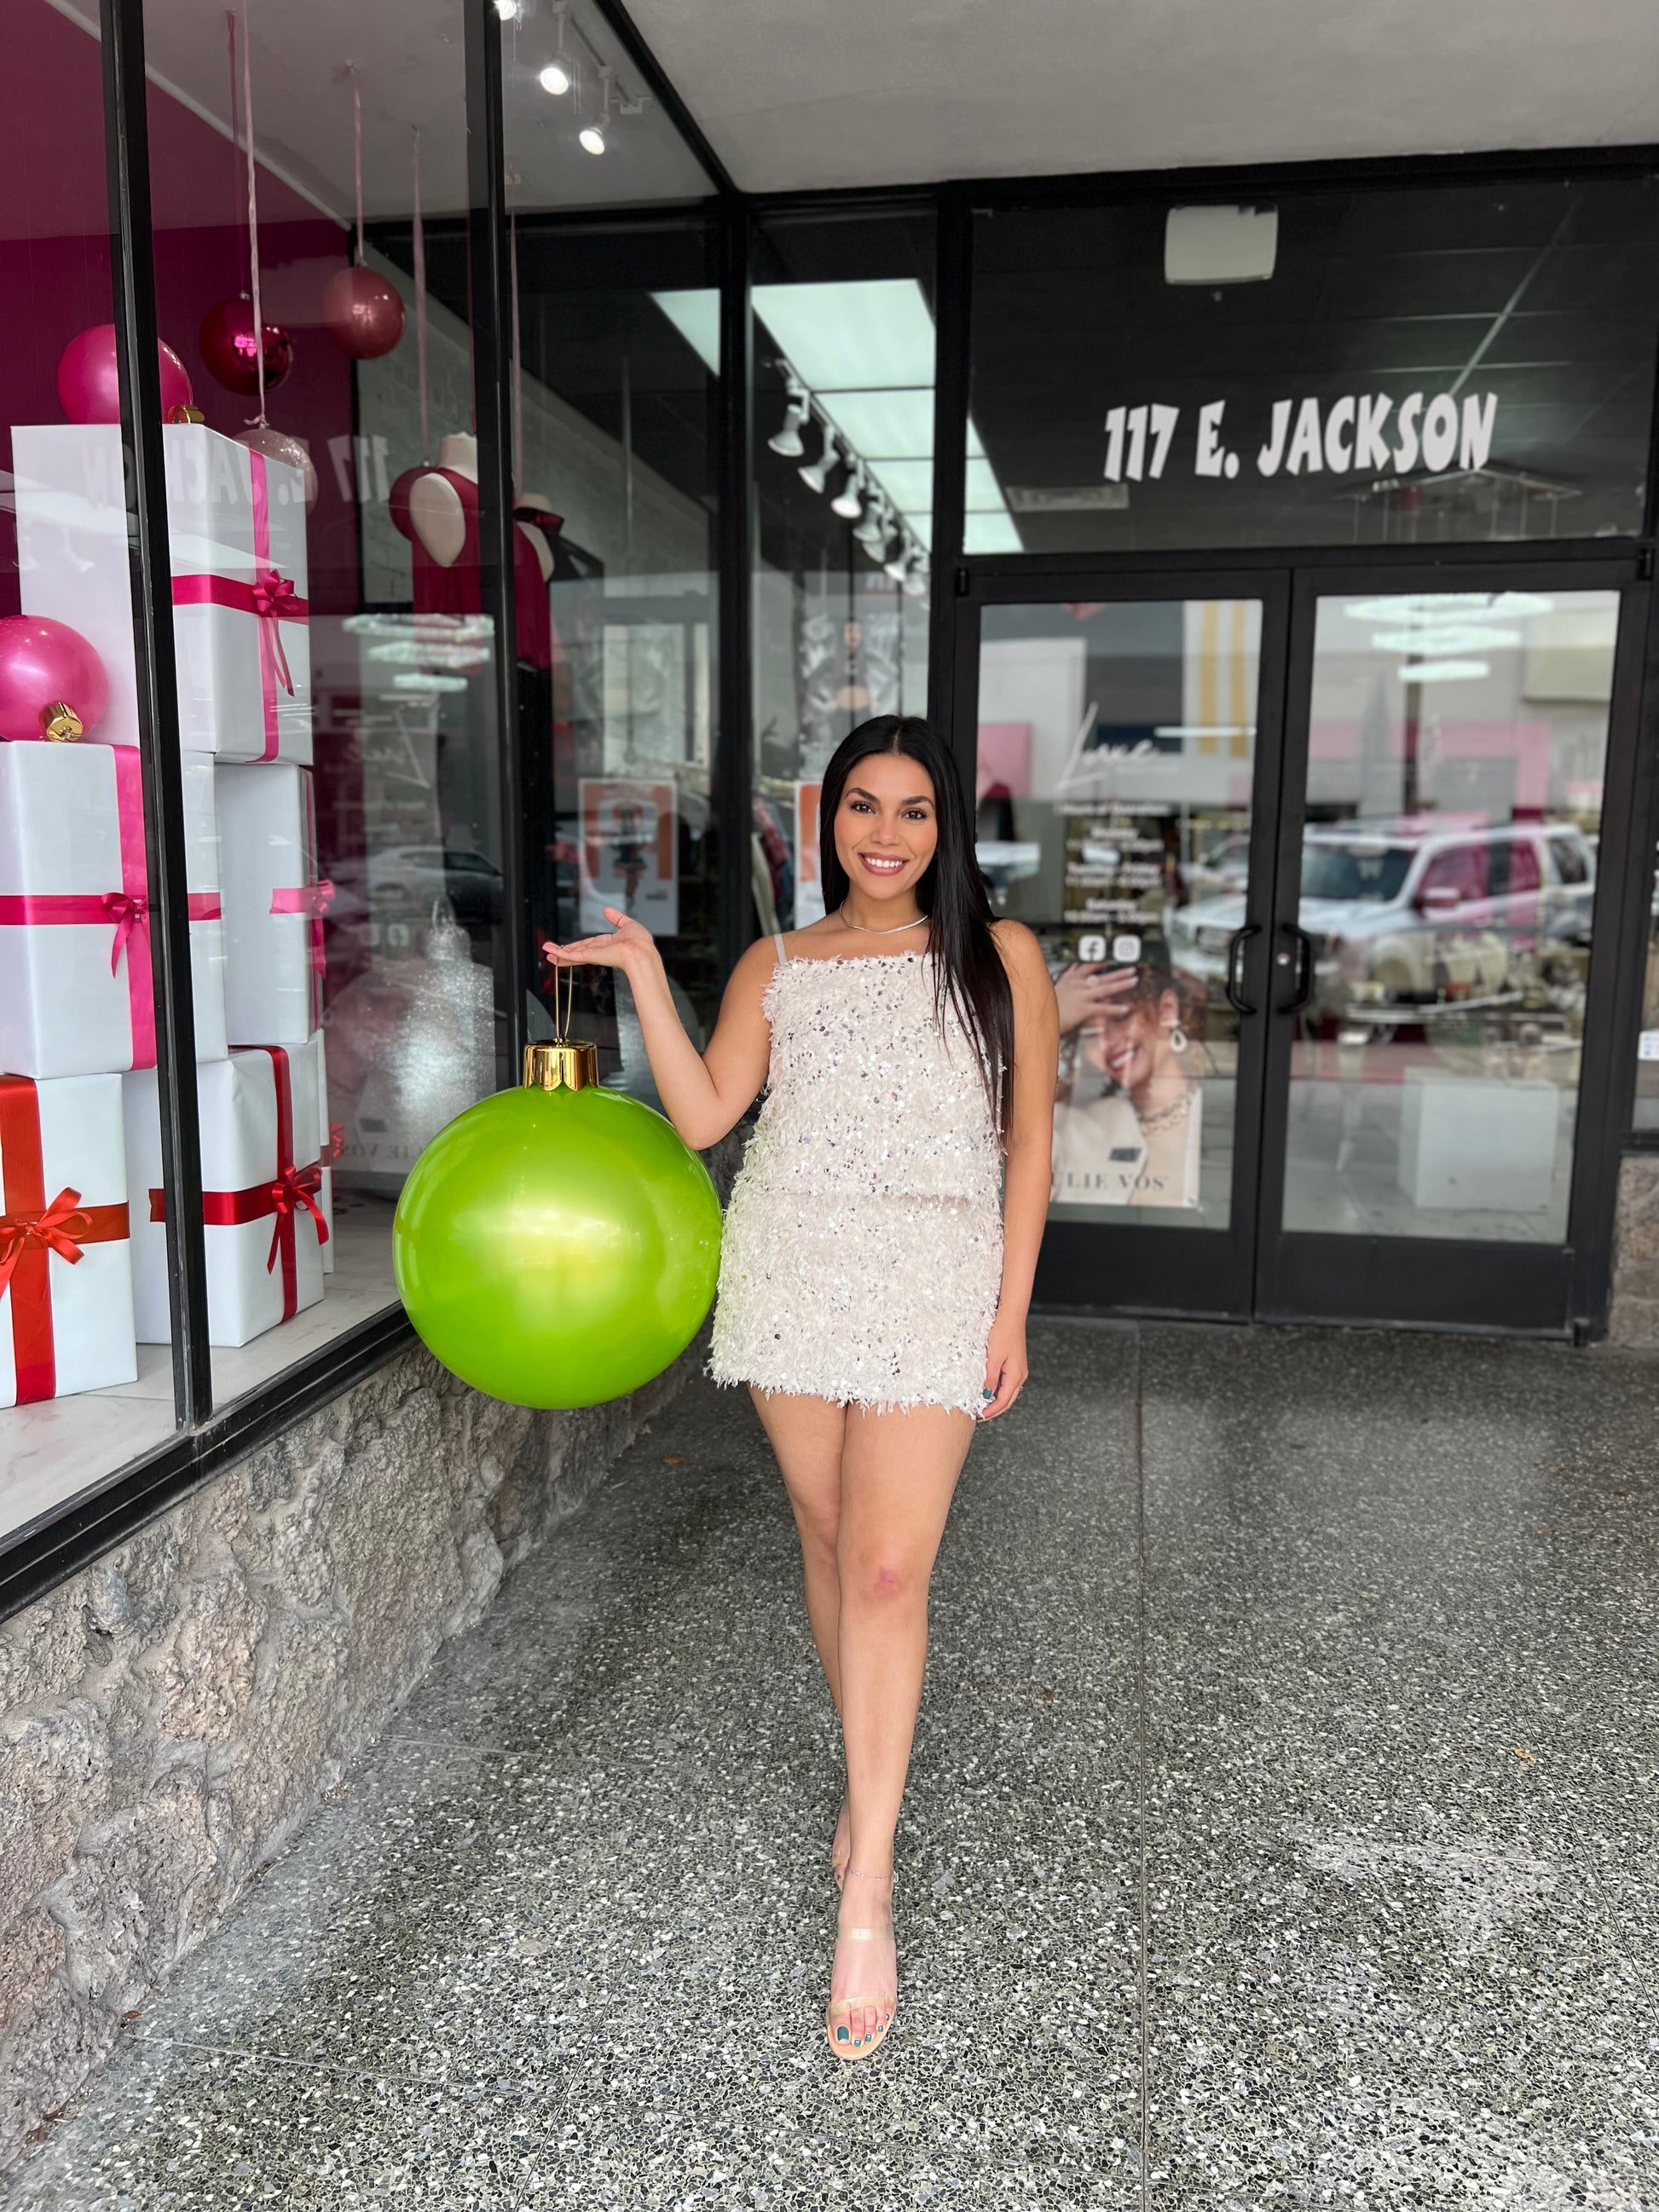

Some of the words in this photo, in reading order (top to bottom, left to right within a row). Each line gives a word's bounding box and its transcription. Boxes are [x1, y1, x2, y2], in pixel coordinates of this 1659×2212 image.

[1104, 403, 1179, 482] 117
[1195, 400, 1240, 479] E.
[1257, 392, 1498, 476] JACKSON
[1051, 1172, 1109, 1189] LIE
[1119, 1174, 1169, 1191] VOS
